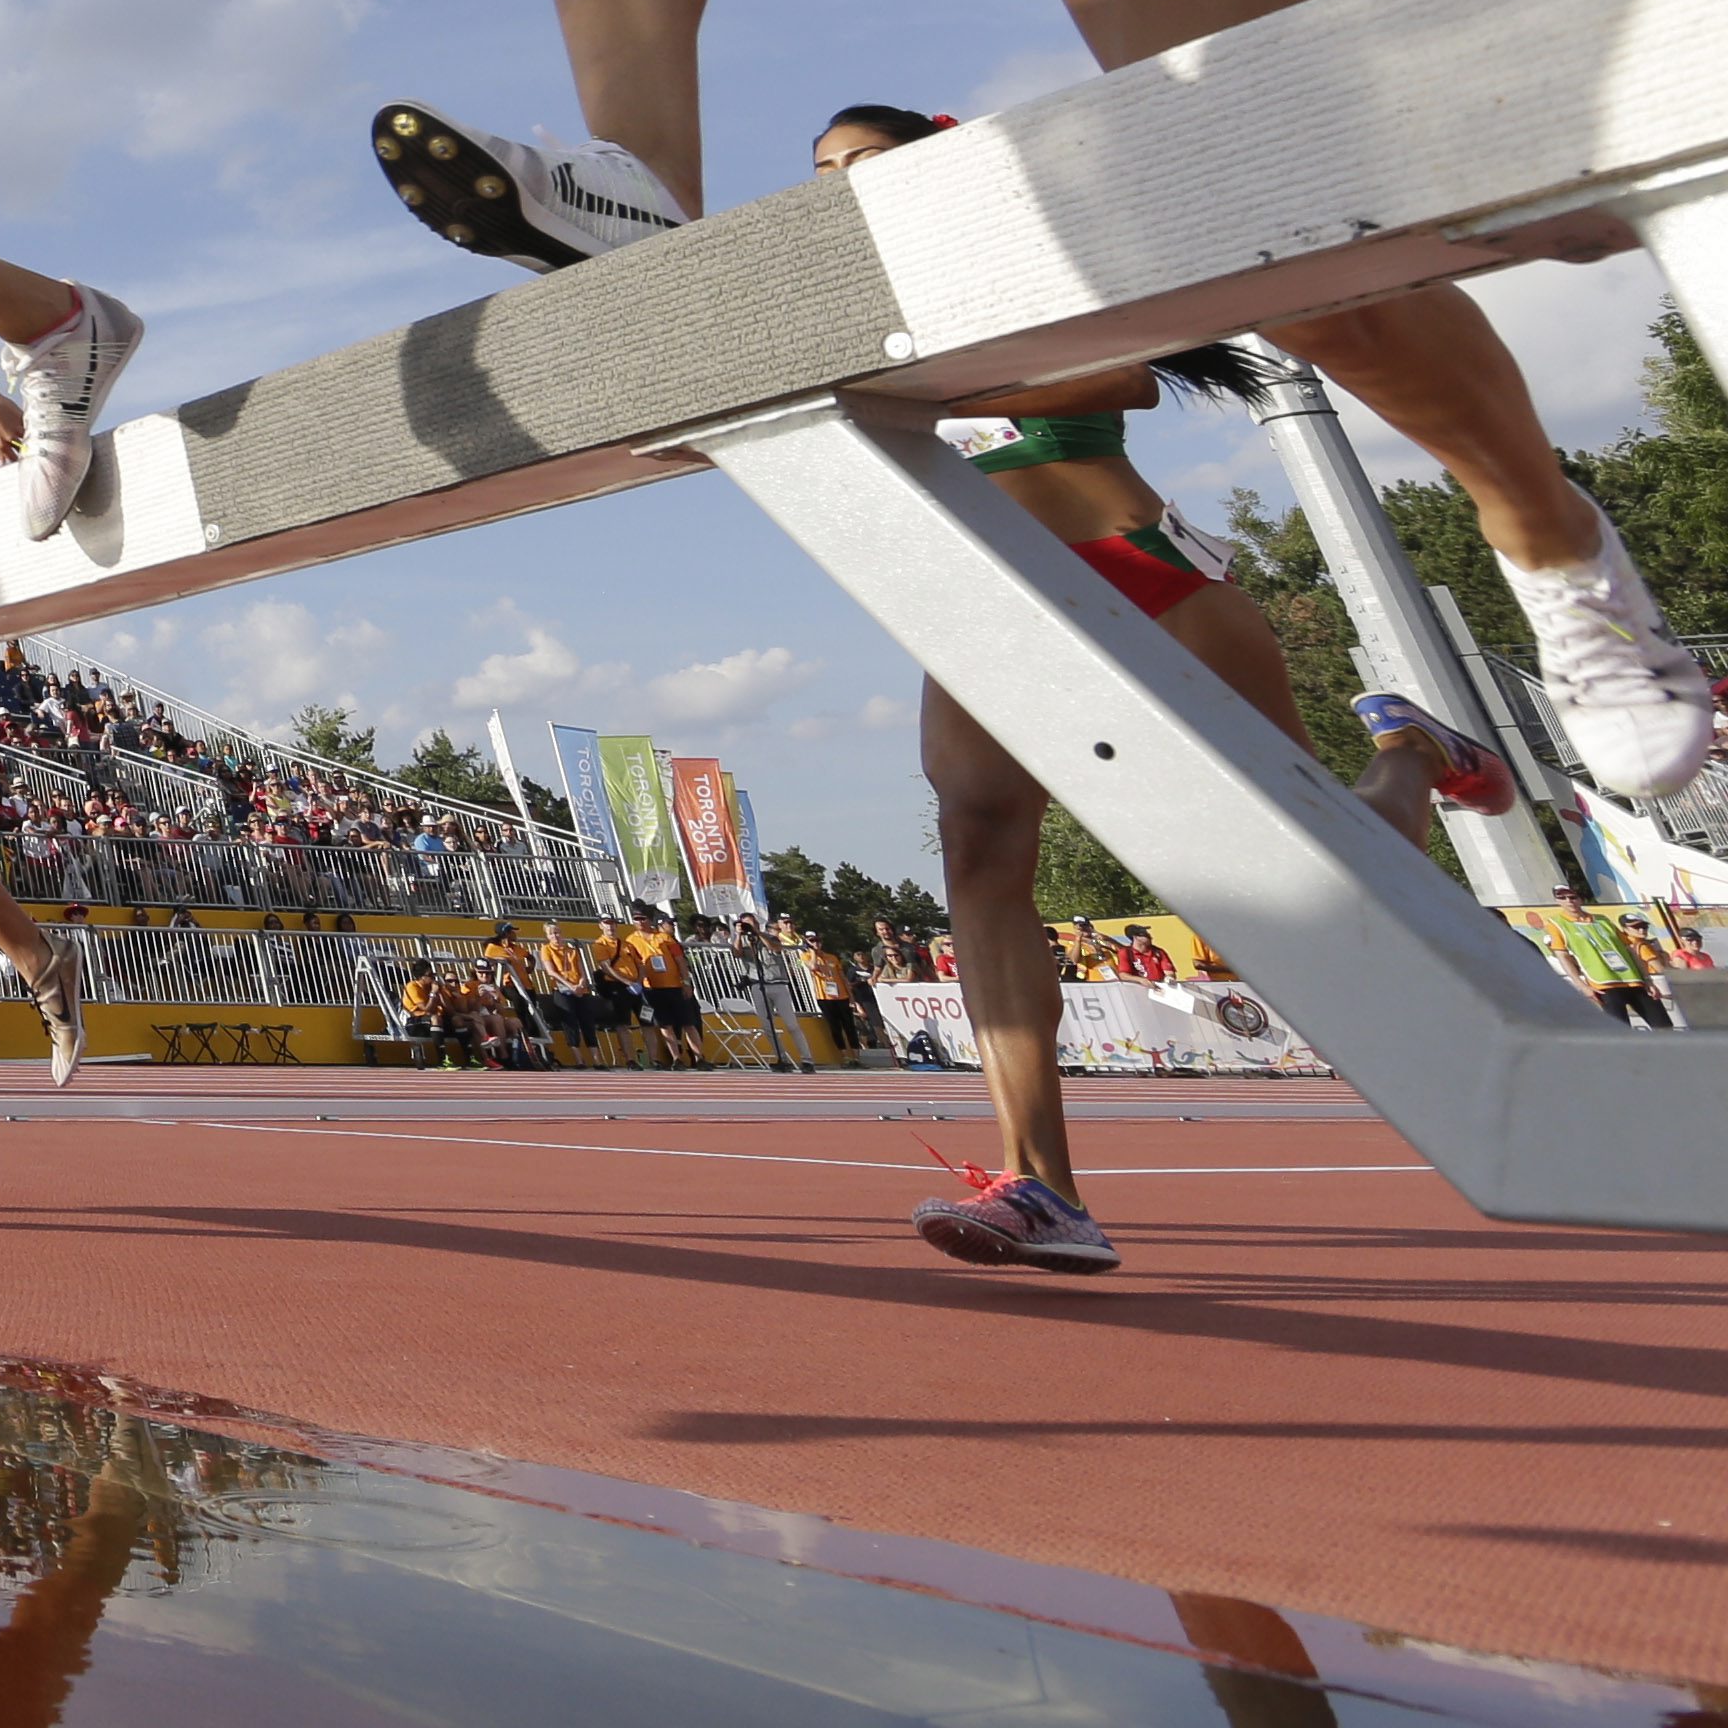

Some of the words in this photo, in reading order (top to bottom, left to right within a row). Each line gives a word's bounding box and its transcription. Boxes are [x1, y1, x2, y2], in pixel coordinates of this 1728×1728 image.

[627, 752, 662, 848] TORONTO
[688, 819, 714, 864] 2015
[694, 774, 728, 863] TORONTO
